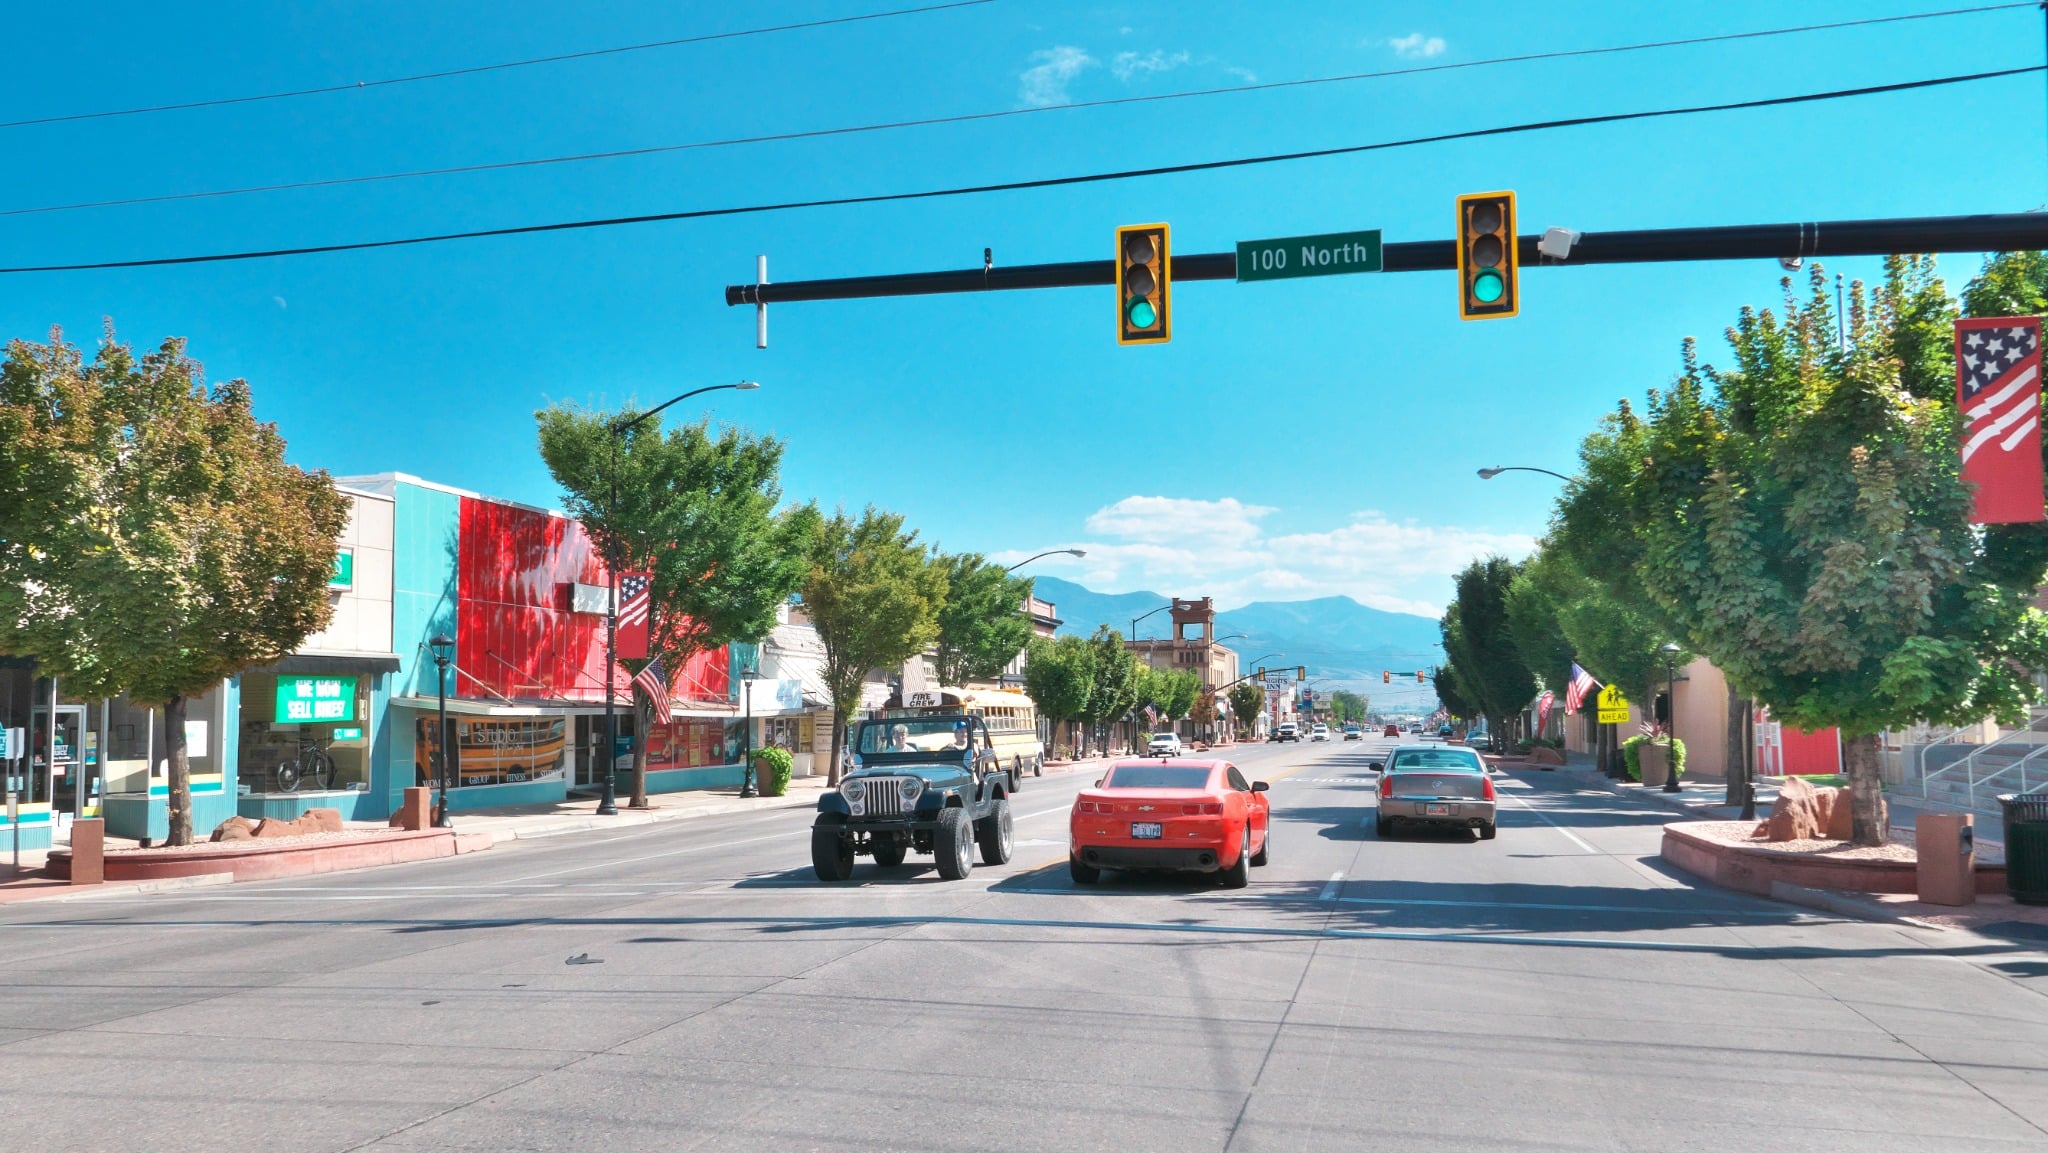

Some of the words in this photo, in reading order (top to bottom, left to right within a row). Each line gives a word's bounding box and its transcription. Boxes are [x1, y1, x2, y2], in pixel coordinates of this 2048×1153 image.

[1251, 248, 1287, 272] 100
[1301, 242, 1367, 268] North
[912, 693, 932, 701] FIRE
[288, 700, 312, 718] SELL
[1601, 712, 1628, 721] AHEAD
[478, 728, 518, 743] STUDIO
[469, 775, 490, 785] GROUP
[506, 773, 526, 783] FITNESS
